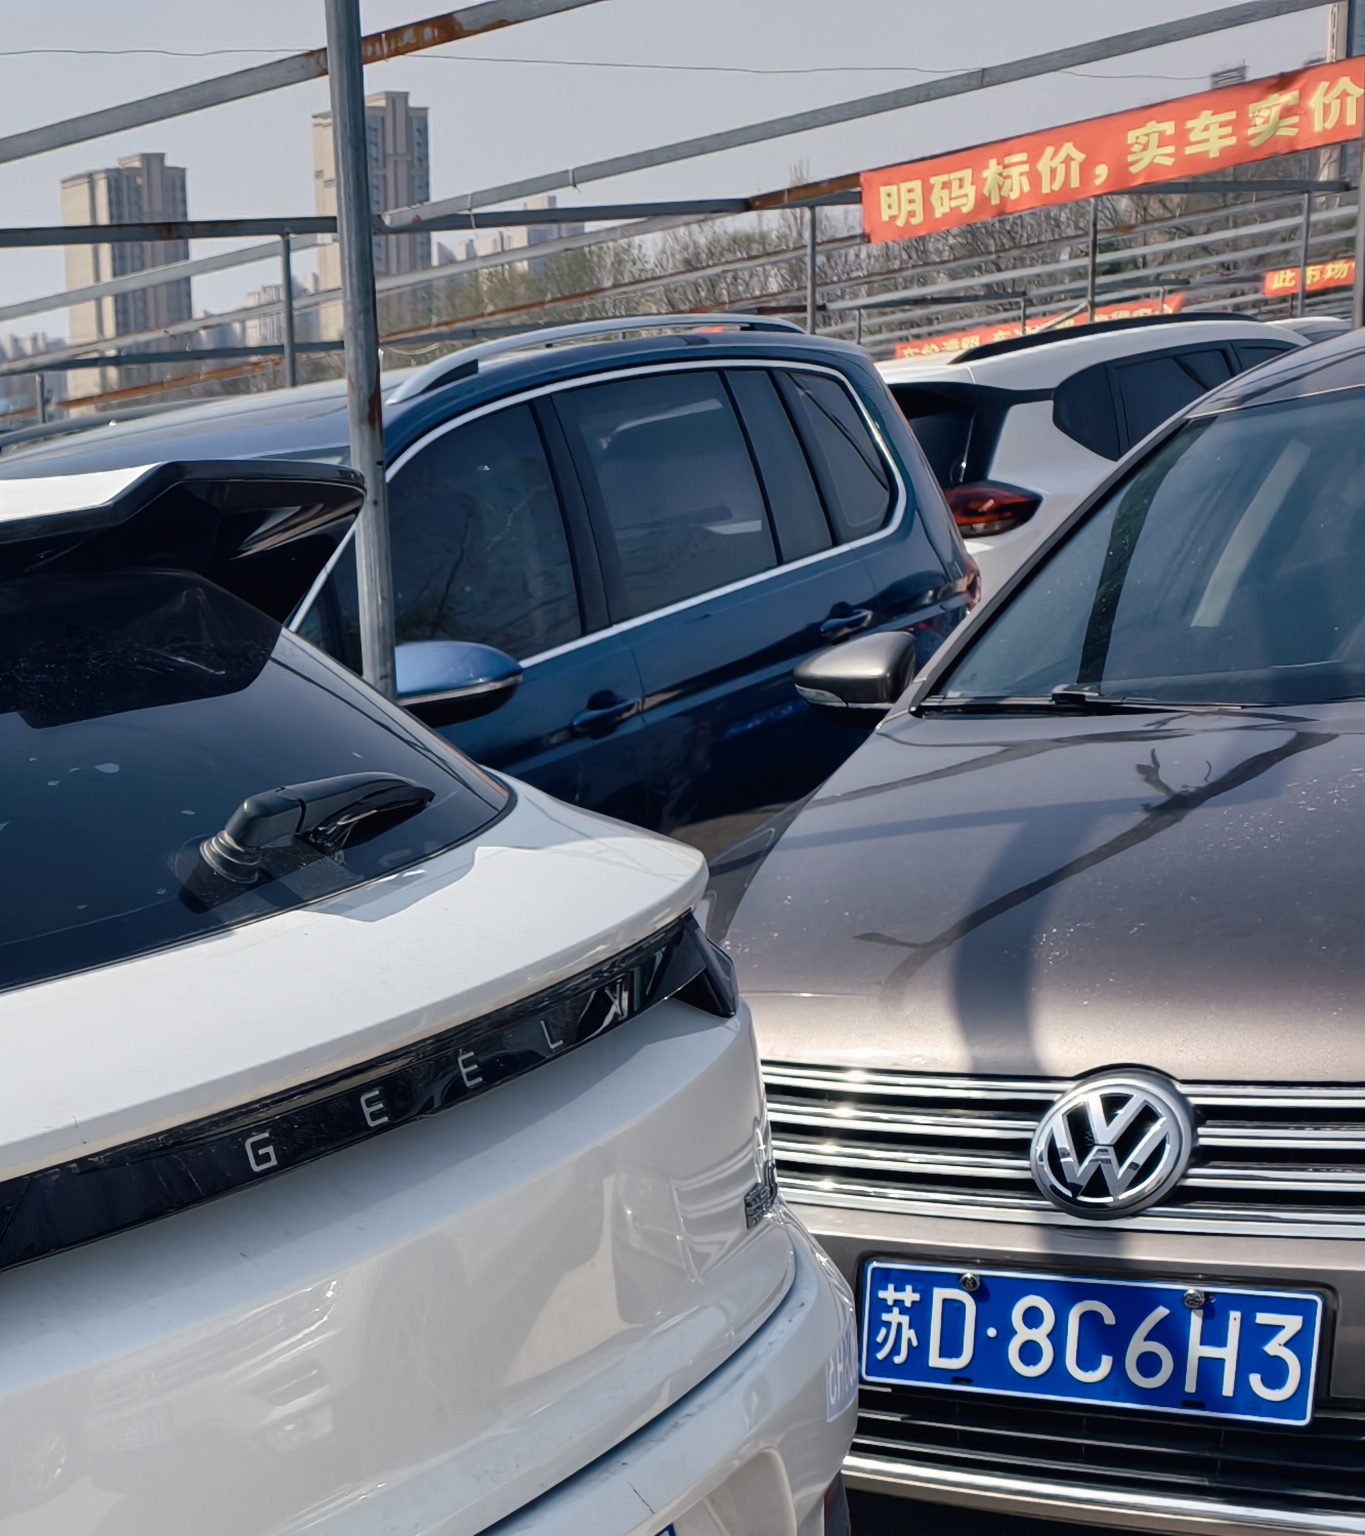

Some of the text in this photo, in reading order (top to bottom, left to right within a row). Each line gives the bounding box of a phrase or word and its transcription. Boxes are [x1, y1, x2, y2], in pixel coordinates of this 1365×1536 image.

[879, 76, 1364, 228] 明码标价，实车实价
[244, 978, 625, 1173] GEELY
[874, 1283, 1304, 1402] 苏D·8C6H3
